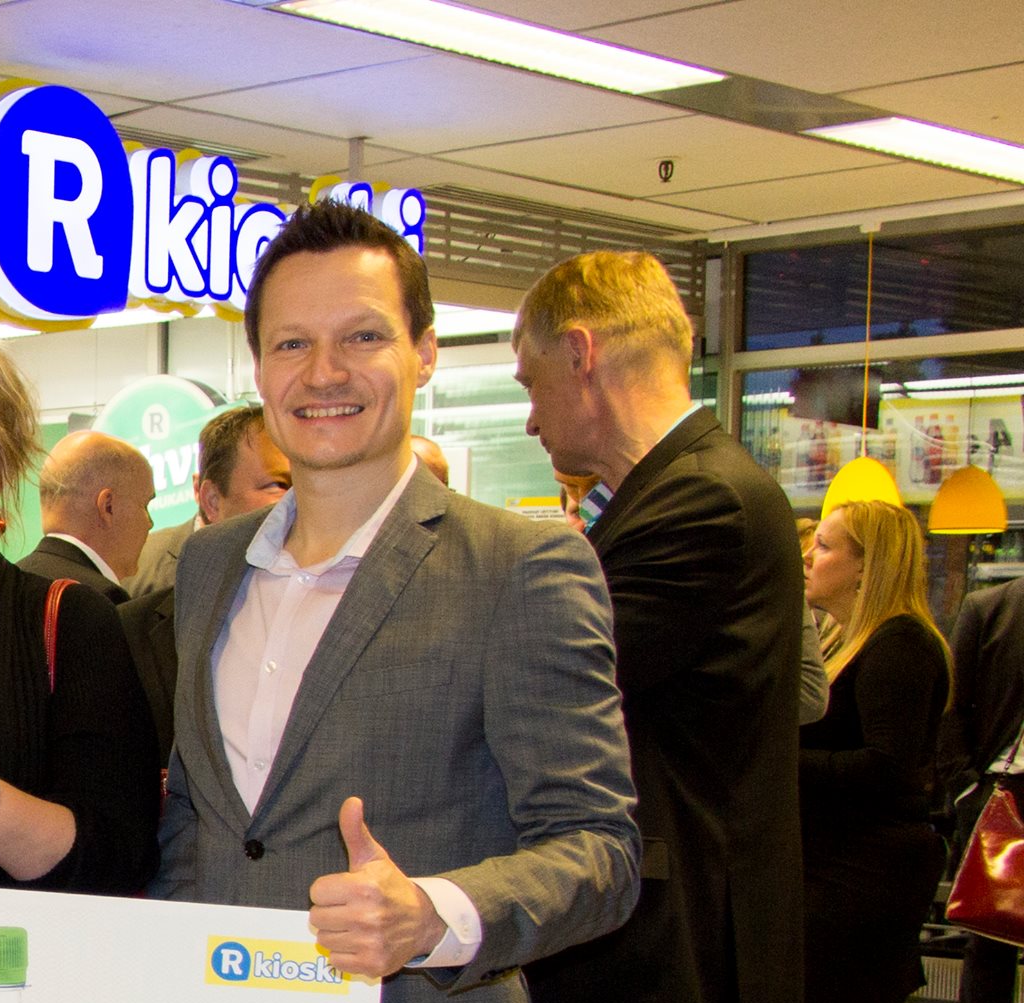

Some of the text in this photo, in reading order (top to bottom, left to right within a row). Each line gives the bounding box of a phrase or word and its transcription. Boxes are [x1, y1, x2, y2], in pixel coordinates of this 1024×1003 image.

[22, 129, 104, 280] R
[149, 412, 164, 434] R
[220, 948, 244, 975] R
